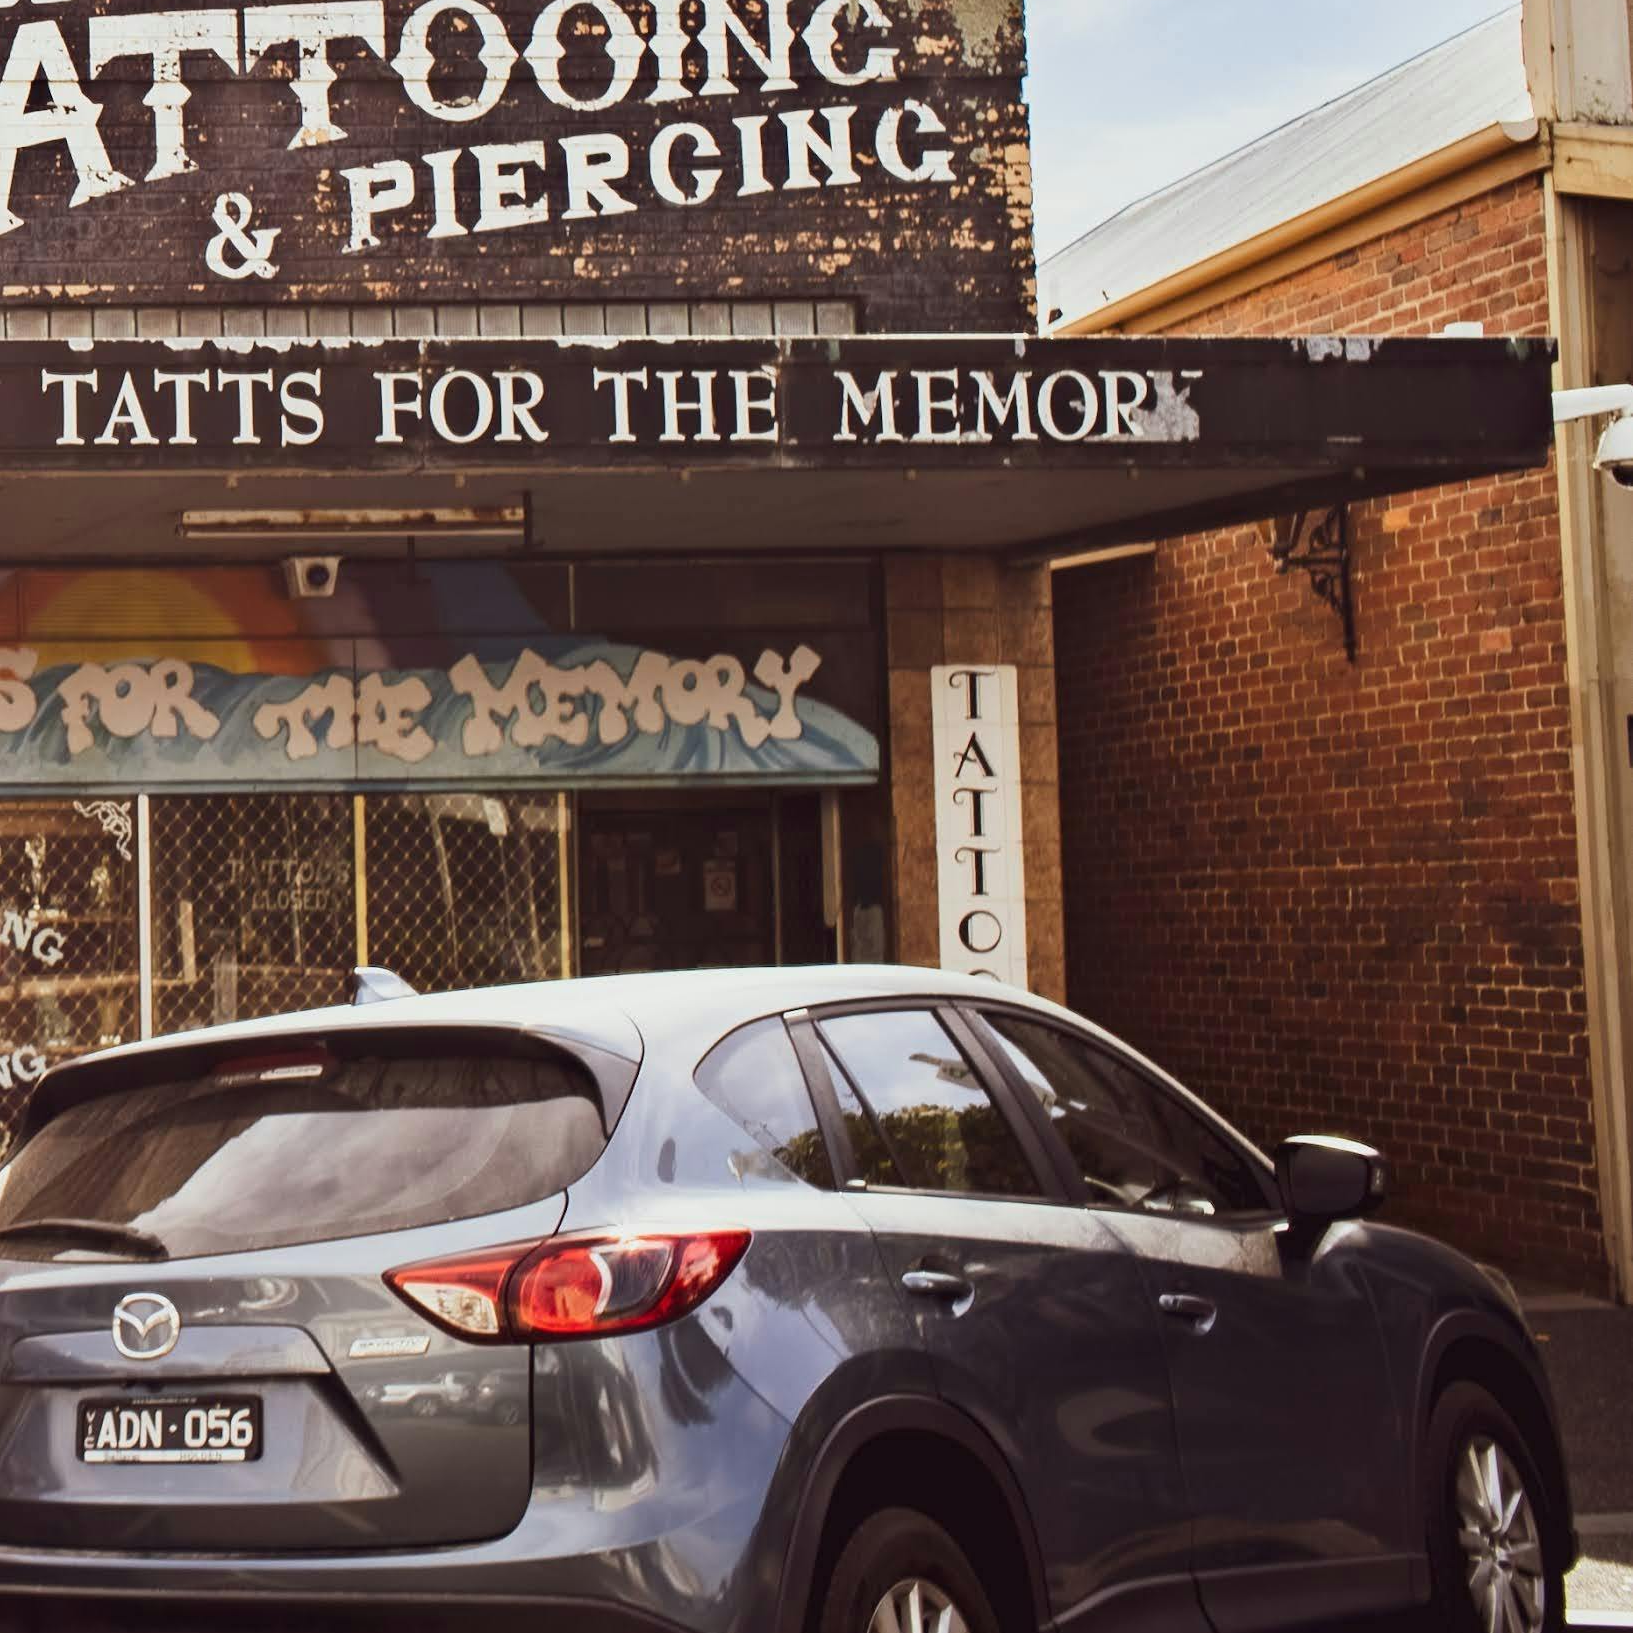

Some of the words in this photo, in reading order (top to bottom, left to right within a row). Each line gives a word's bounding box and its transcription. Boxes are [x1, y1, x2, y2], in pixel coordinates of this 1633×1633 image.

[205, 191, 281, 280] &
[339, 98, 956, 256] PIERCING
[41, 369, 324, 448] TATTS
[373, 369, 549, 444] FOR
[593, 369, 779, 443] THE
[56, 654, 221, 756] FOR
[253, 672, 437, 762] THE
[449, 644, 822, 761] MEMORY
[948, 669, 1003, 984] TATTO
